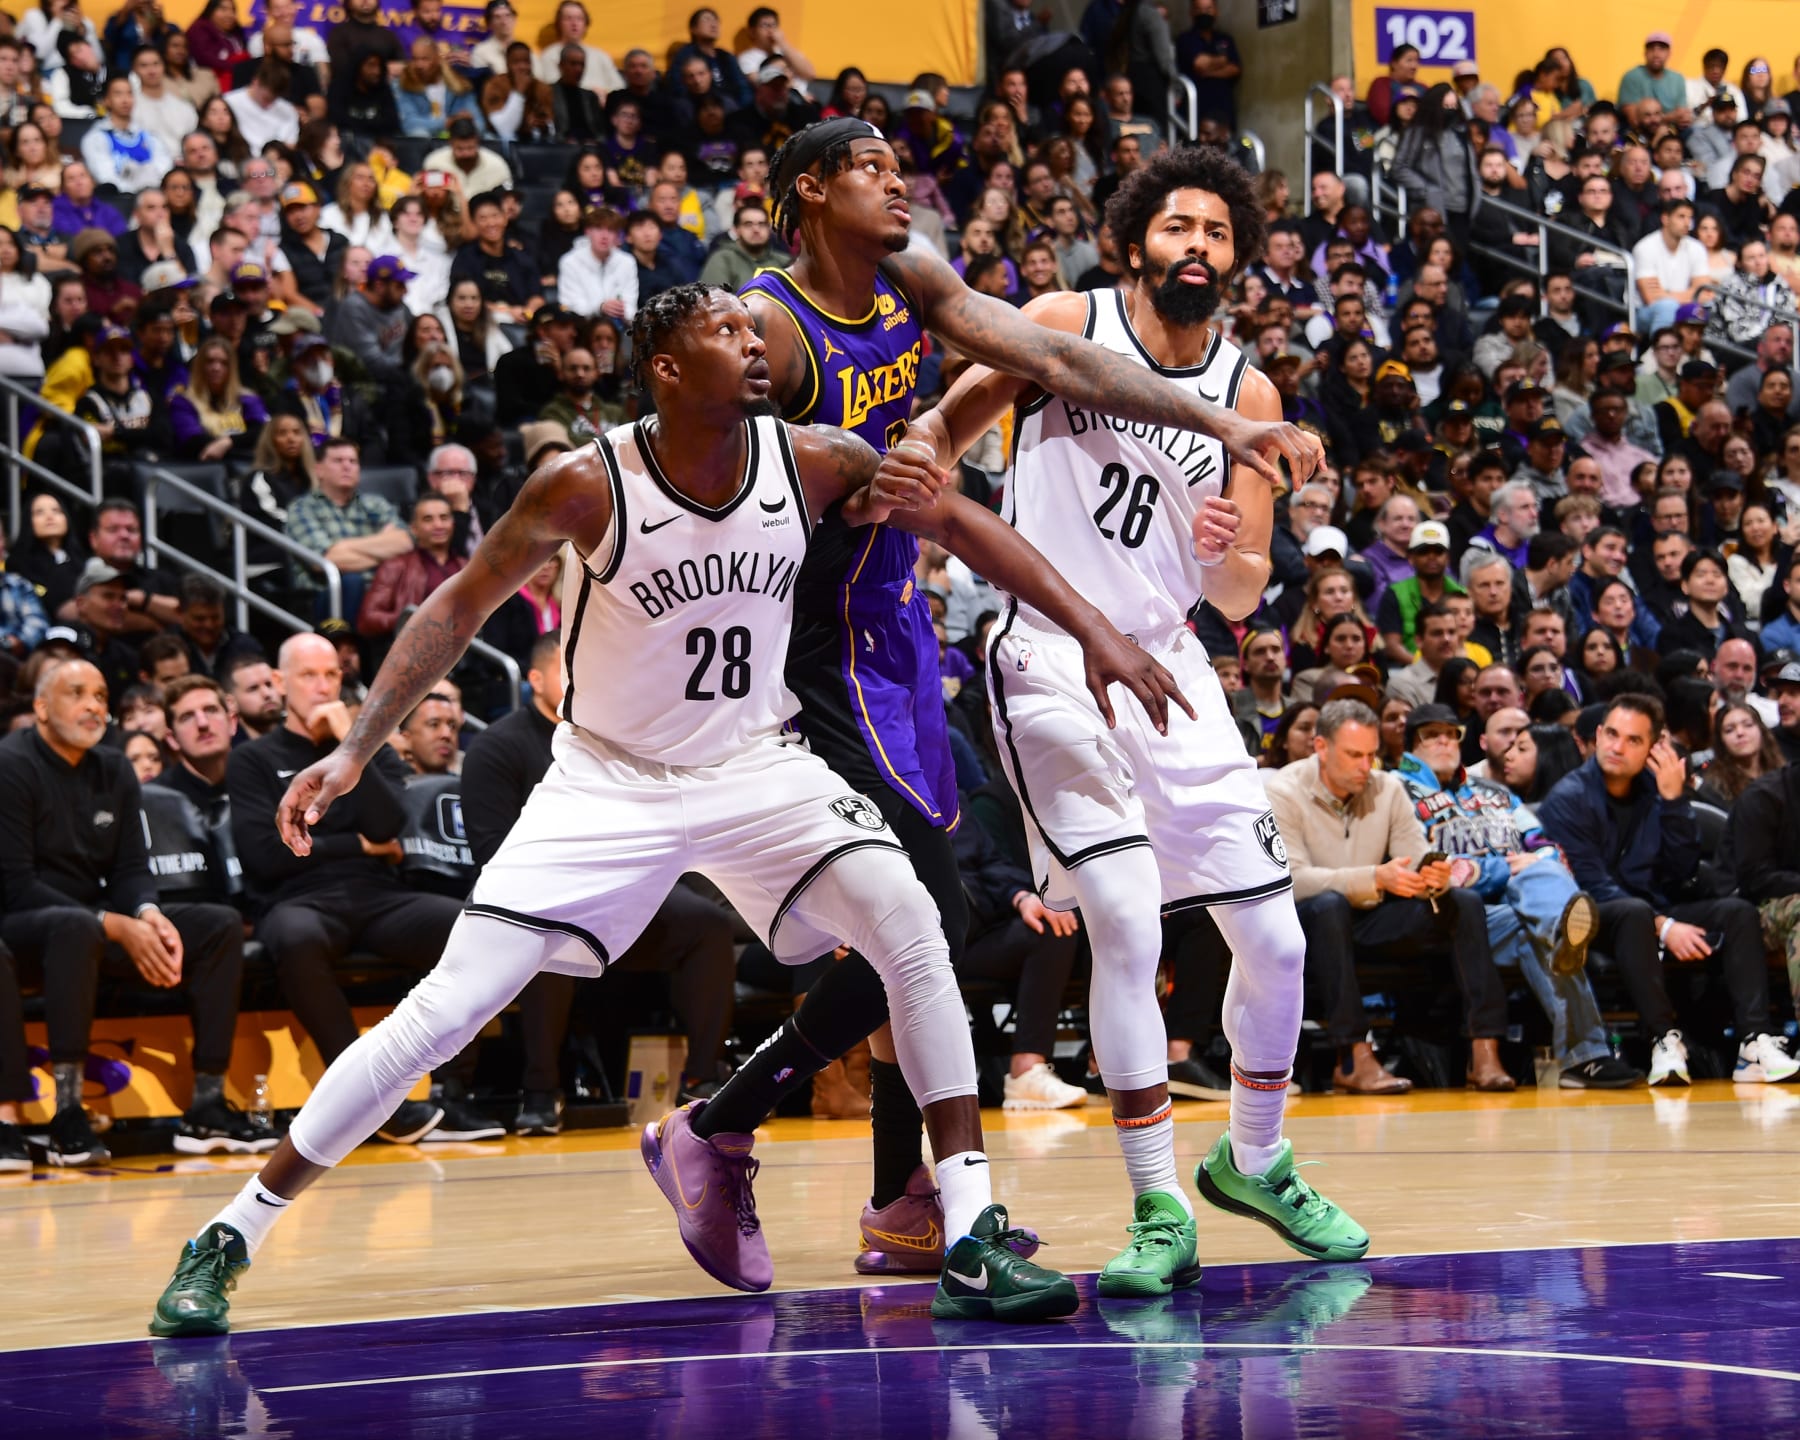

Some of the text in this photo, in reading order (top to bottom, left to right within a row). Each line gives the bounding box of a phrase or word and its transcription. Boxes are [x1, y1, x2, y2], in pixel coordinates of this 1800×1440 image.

[1386, 14, 1467, 60] 102
[837, 340, 921, 431] LAKERS
[761, 516, 790, 529] Webull
[1093, 462, 1160, 549] 26
[629, 551, 800, 619] BROOKLYN
[685, 625, 751, 701] 28
